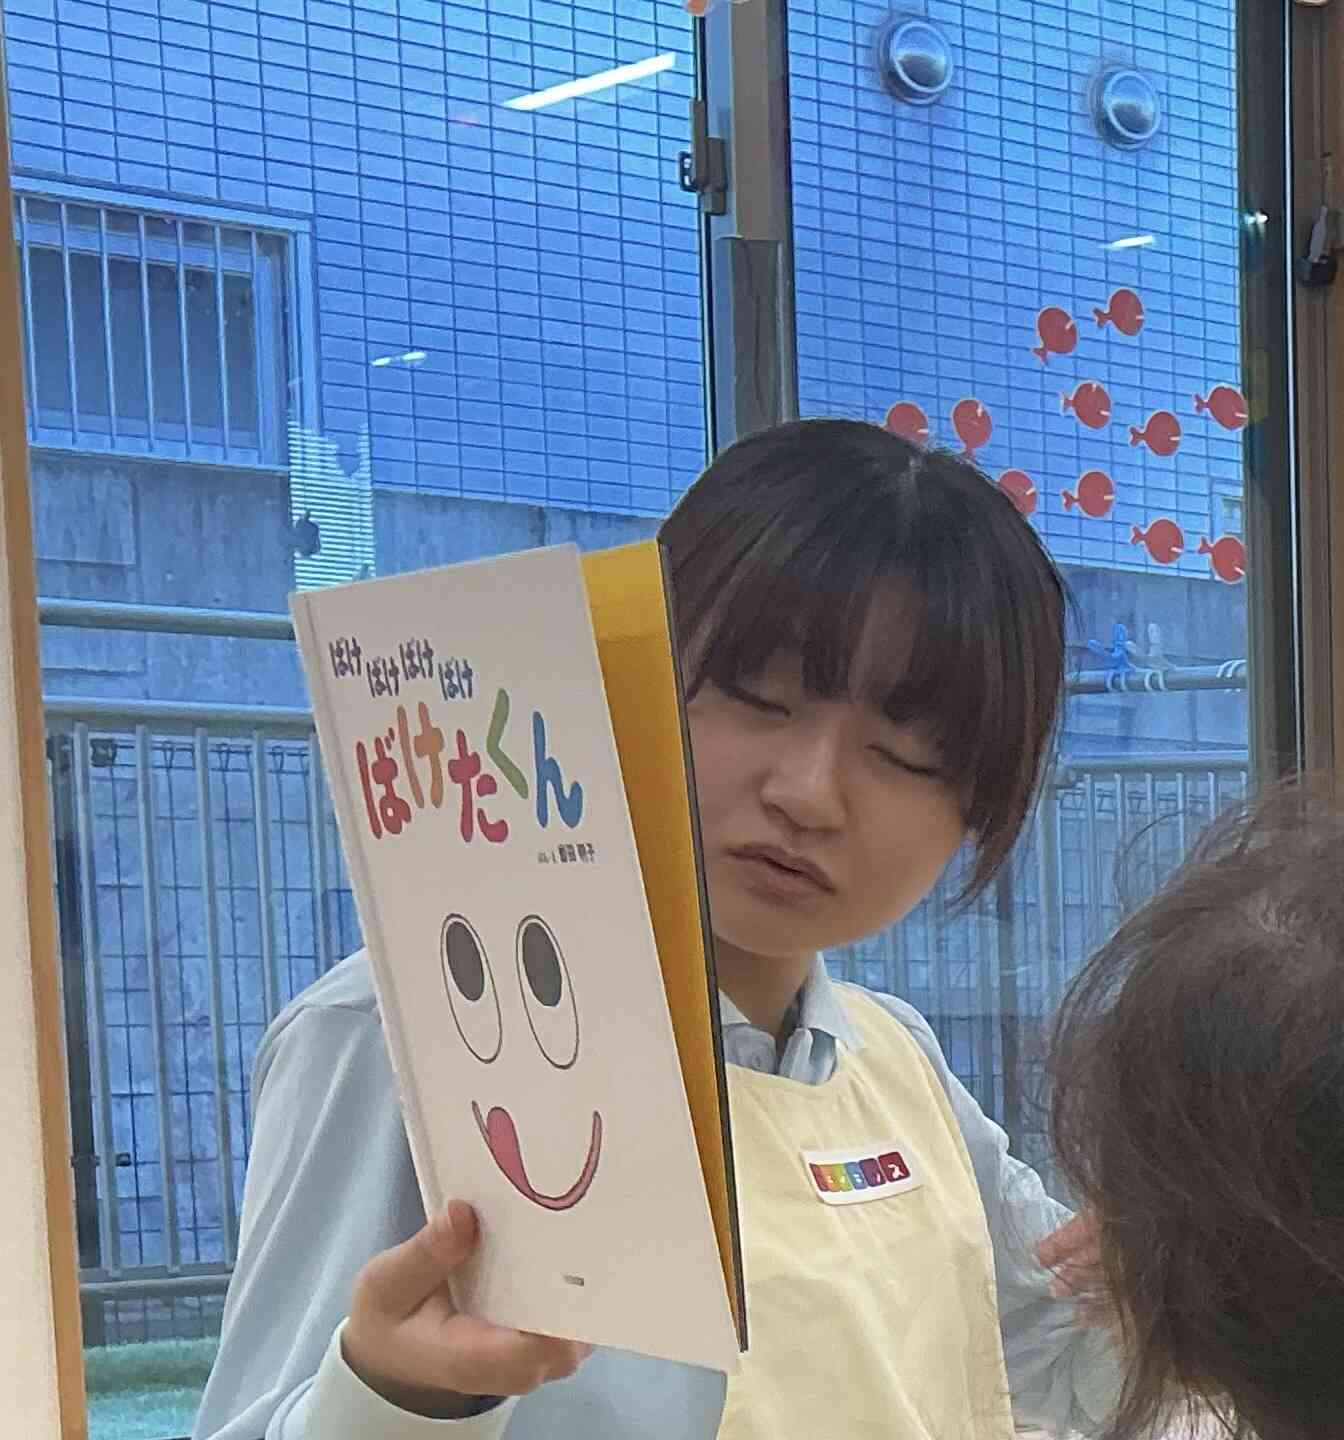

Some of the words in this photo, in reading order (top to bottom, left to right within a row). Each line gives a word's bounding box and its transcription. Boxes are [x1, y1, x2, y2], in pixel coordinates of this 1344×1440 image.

[356, 687, 583, 843] ばけたくん
